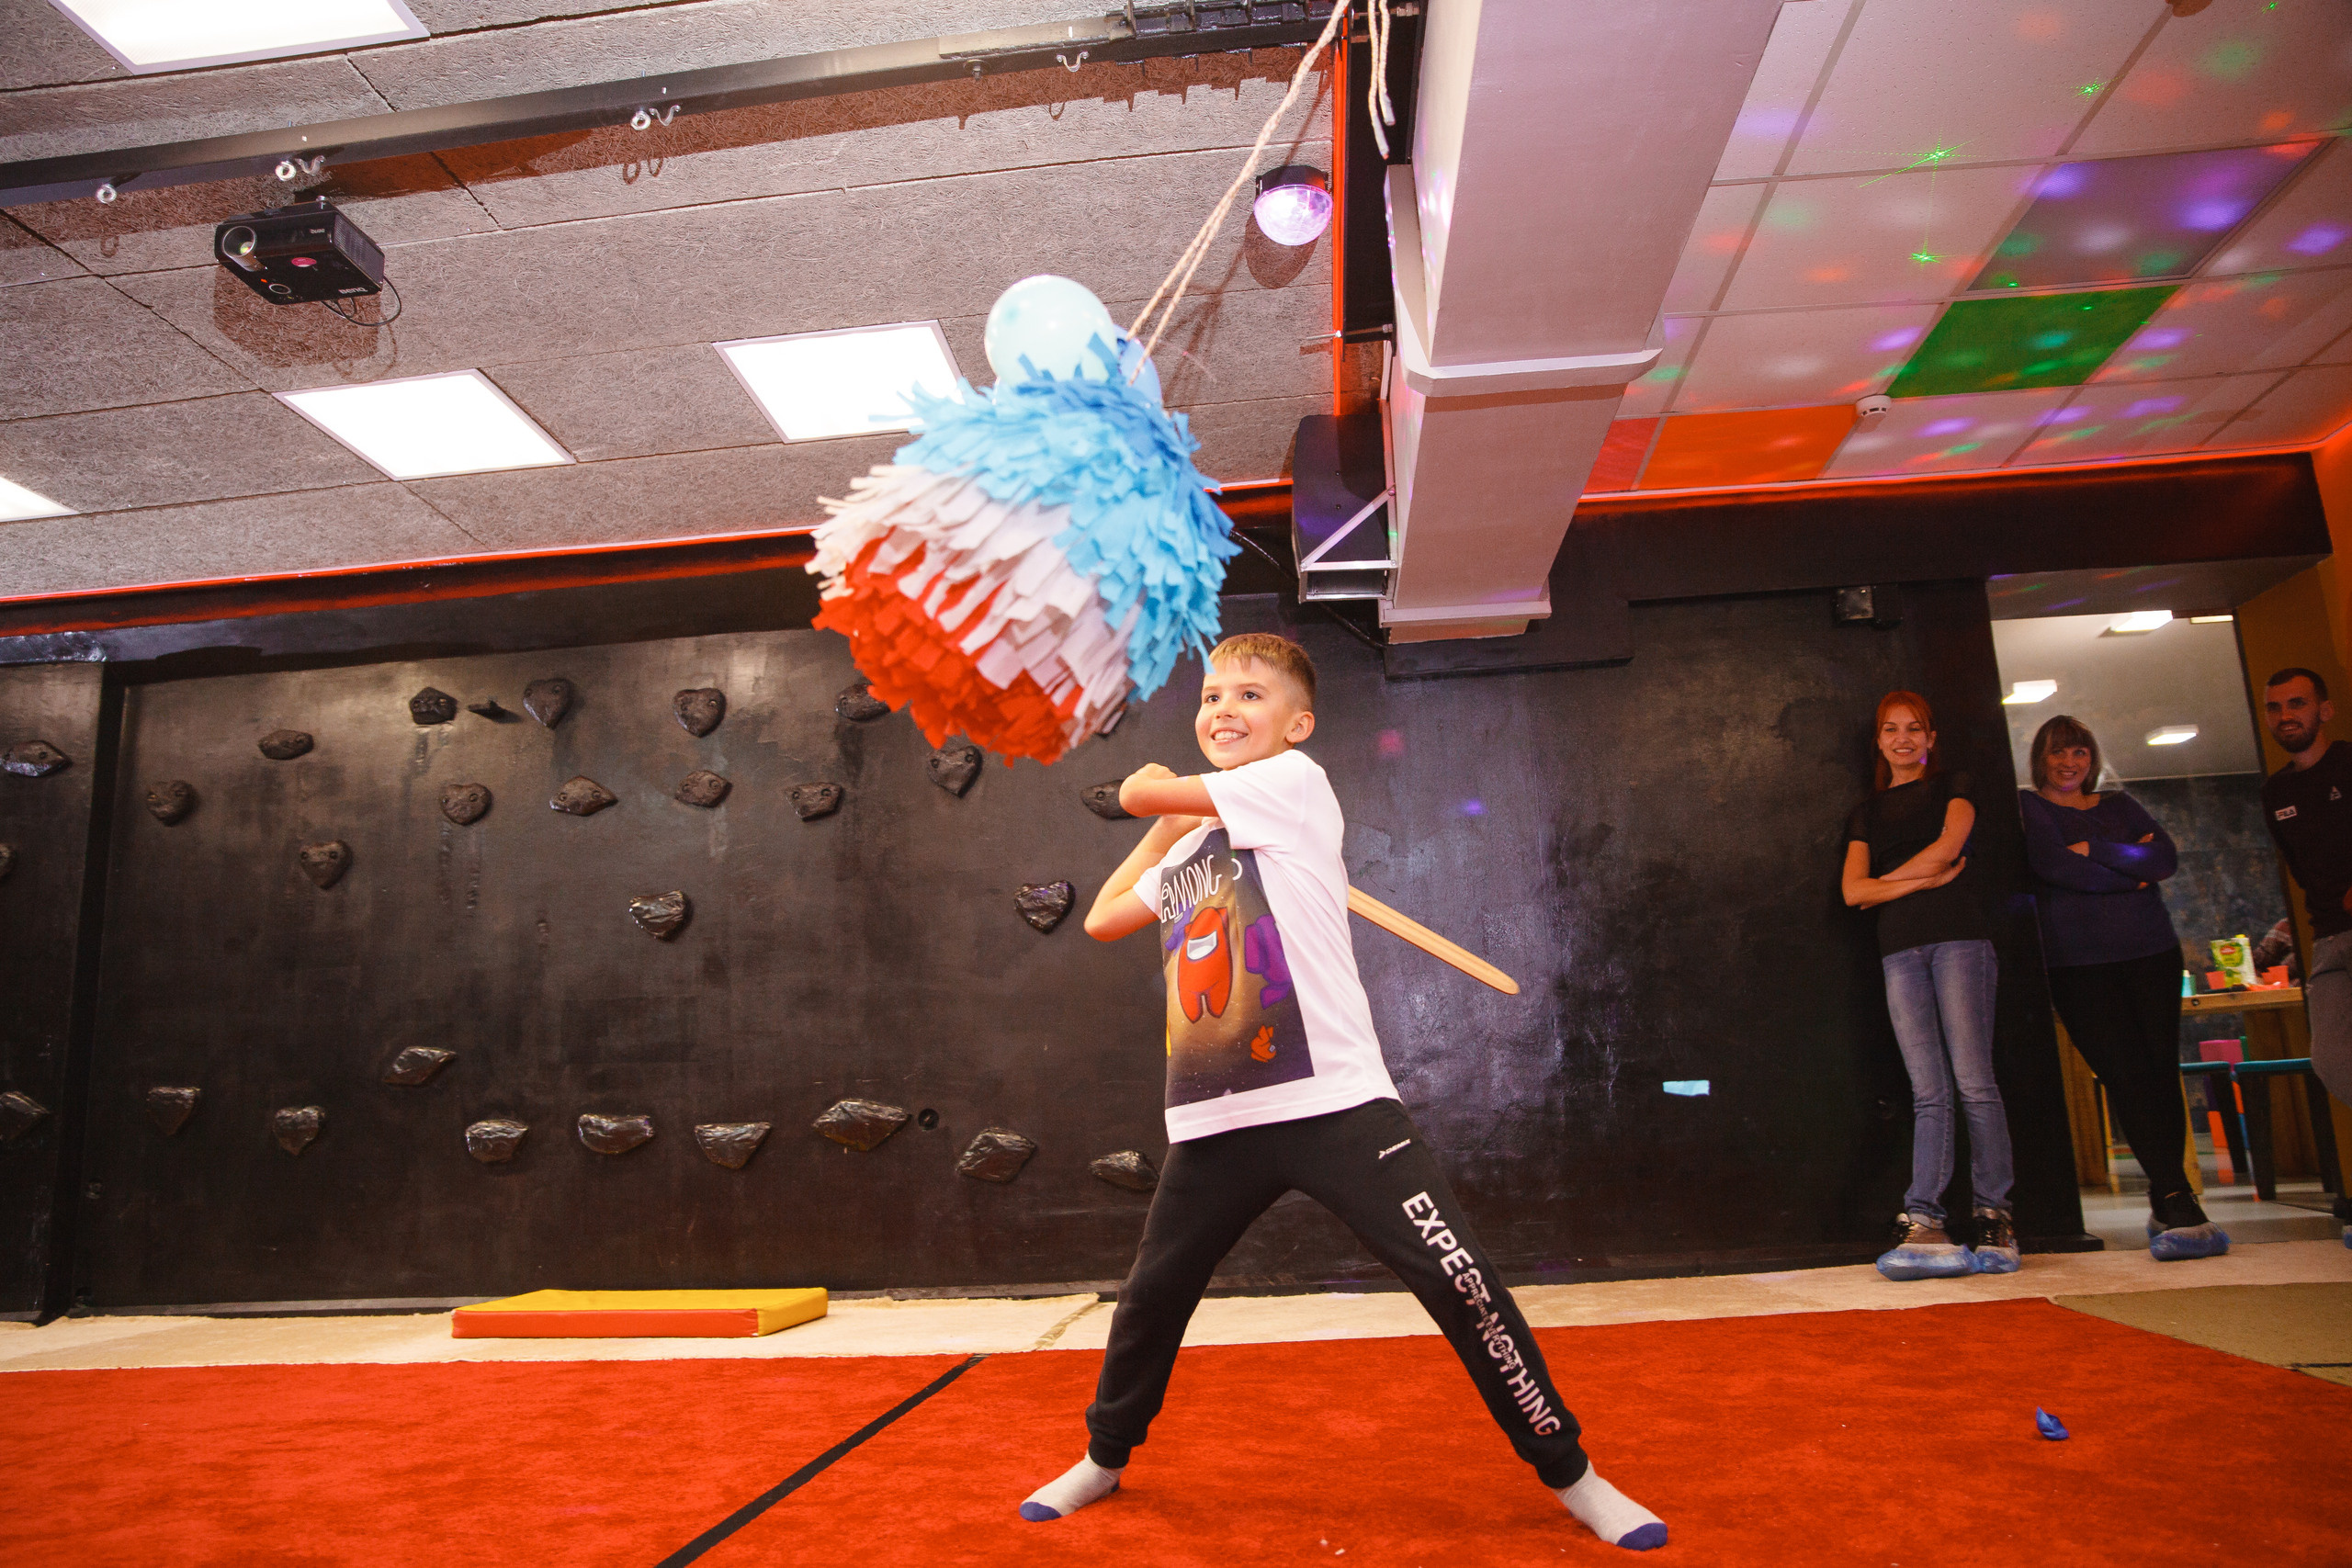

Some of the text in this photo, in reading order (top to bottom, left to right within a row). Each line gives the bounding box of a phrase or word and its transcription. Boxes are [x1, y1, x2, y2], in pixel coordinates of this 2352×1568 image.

[1402, 1191, 1560, 1437] EXPECT NOTHING
[1462, 1272, 1517, 1370] APPRECIATE EVERYTHING
